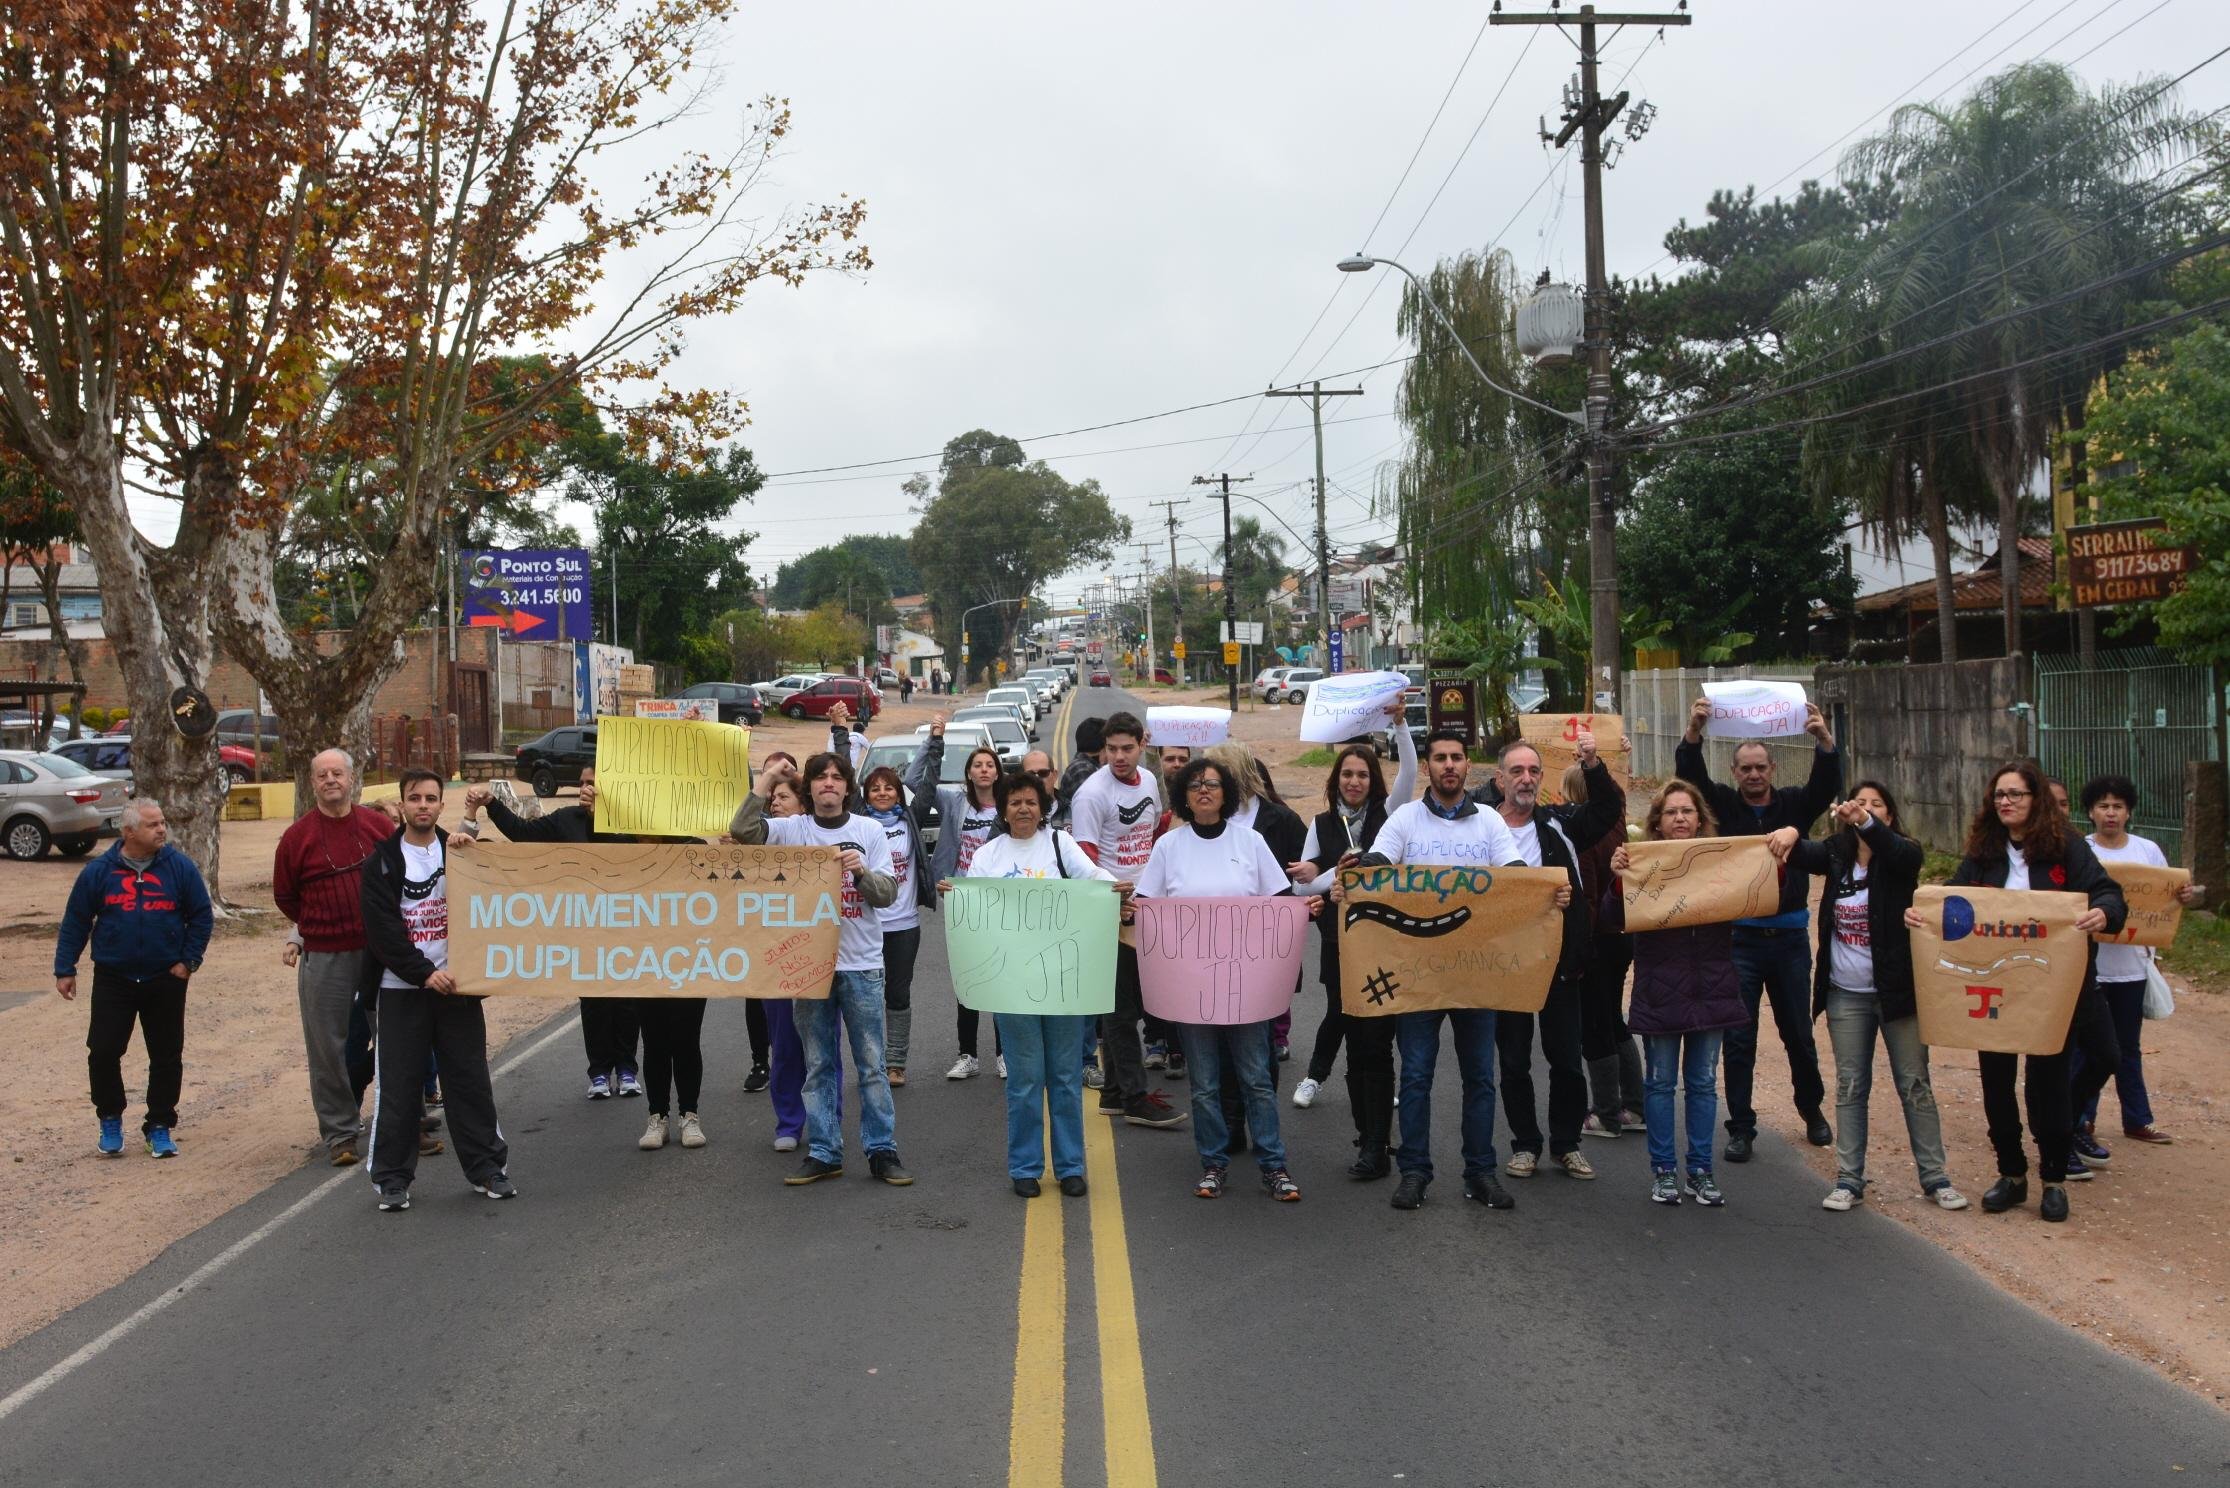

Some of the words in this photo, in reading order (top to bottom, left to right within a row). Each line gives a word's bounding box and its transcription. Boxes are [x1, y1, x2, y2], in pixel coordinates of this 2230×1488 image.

[2071, 530, 2154, 557] SERRALH
[500, 559, 552, 574] PONTO
[555, 557, 583, 572] SUL
[534, 574, 544, 582] de
[2095, 551, 2182, 579] 91173684
[2076, 584, 2100, 604] EM
[2104, 579, 2160, 600] GERAL
[639, 702, 677, 712] TRINCA
[422, 916, 448, 929] VICE
[470, 892, 718, 929] MOVIMENTO
[737, 892, 841, 928] PELA
[1141, 898, 1294, 963] DUPLICAÇÃO
[485, 938, 750, 990] DUPLICAÇÃO
